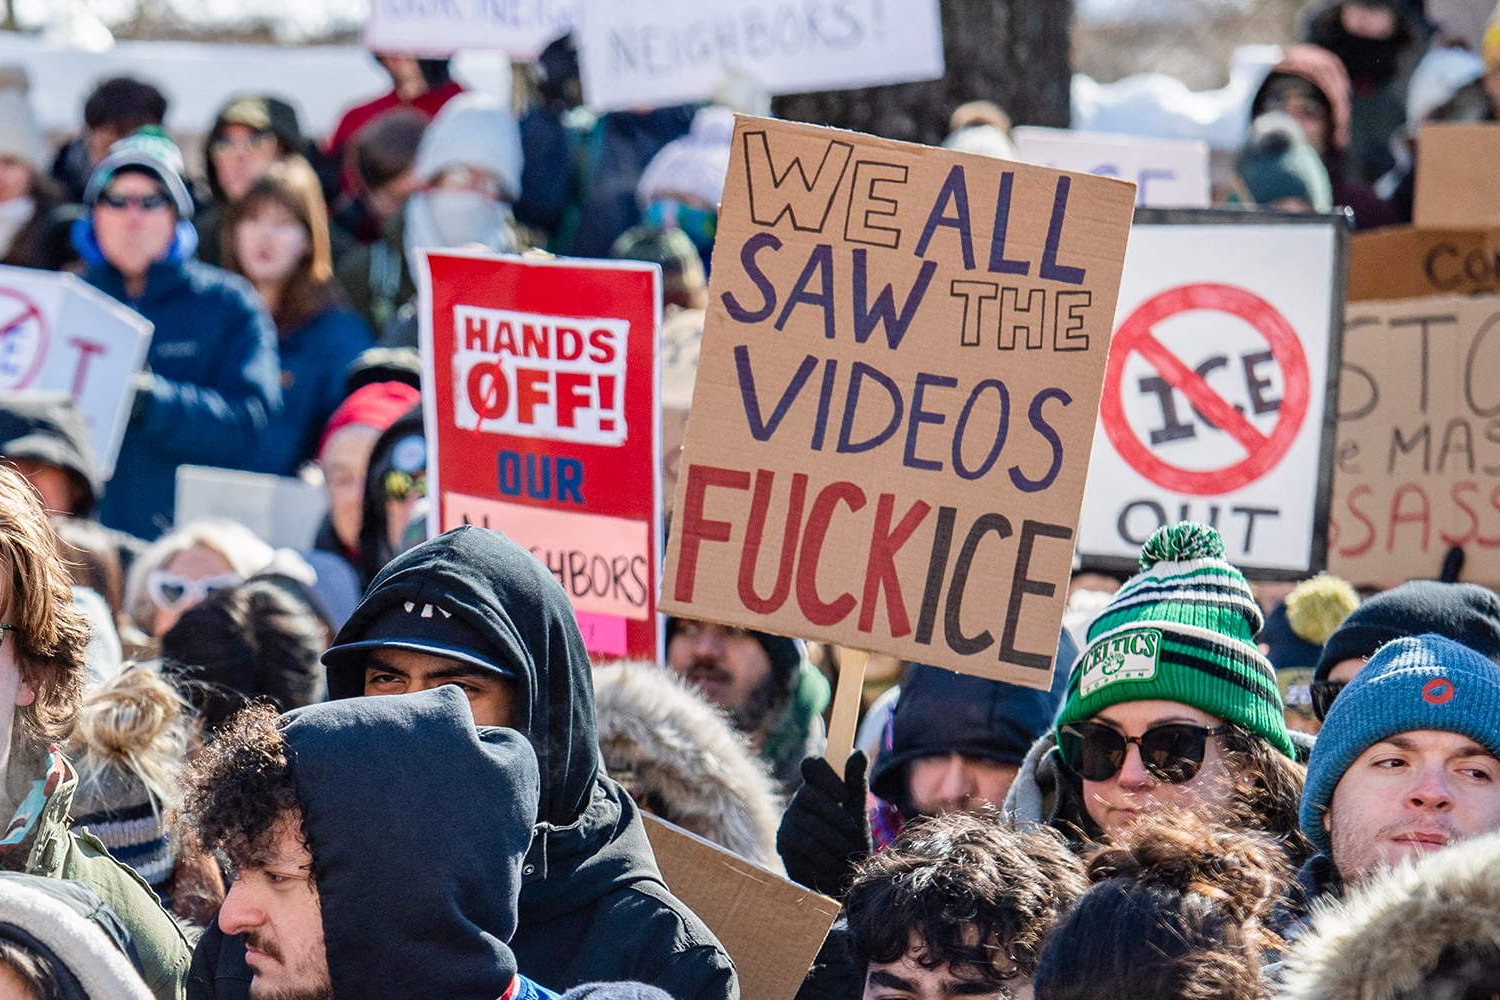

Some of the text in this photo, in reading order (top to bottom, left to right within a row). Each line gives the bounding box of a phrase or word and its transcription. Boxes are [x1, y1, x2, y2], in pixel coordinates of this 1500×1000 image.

[744, 131, 1087, 285] WE ALL
[465, 316, 615, 364] HANDS
[720, 232, 1092, 352] SAW THE
[734, 344, 1073, 493] VIDEOS
[1137, 350, 1284, 446] ICE
[498, 450, 585, 504] OUR
[674, 463, 1074, 671] FUCK ICE
[1083, 632, 1157, 676] CELTICS
